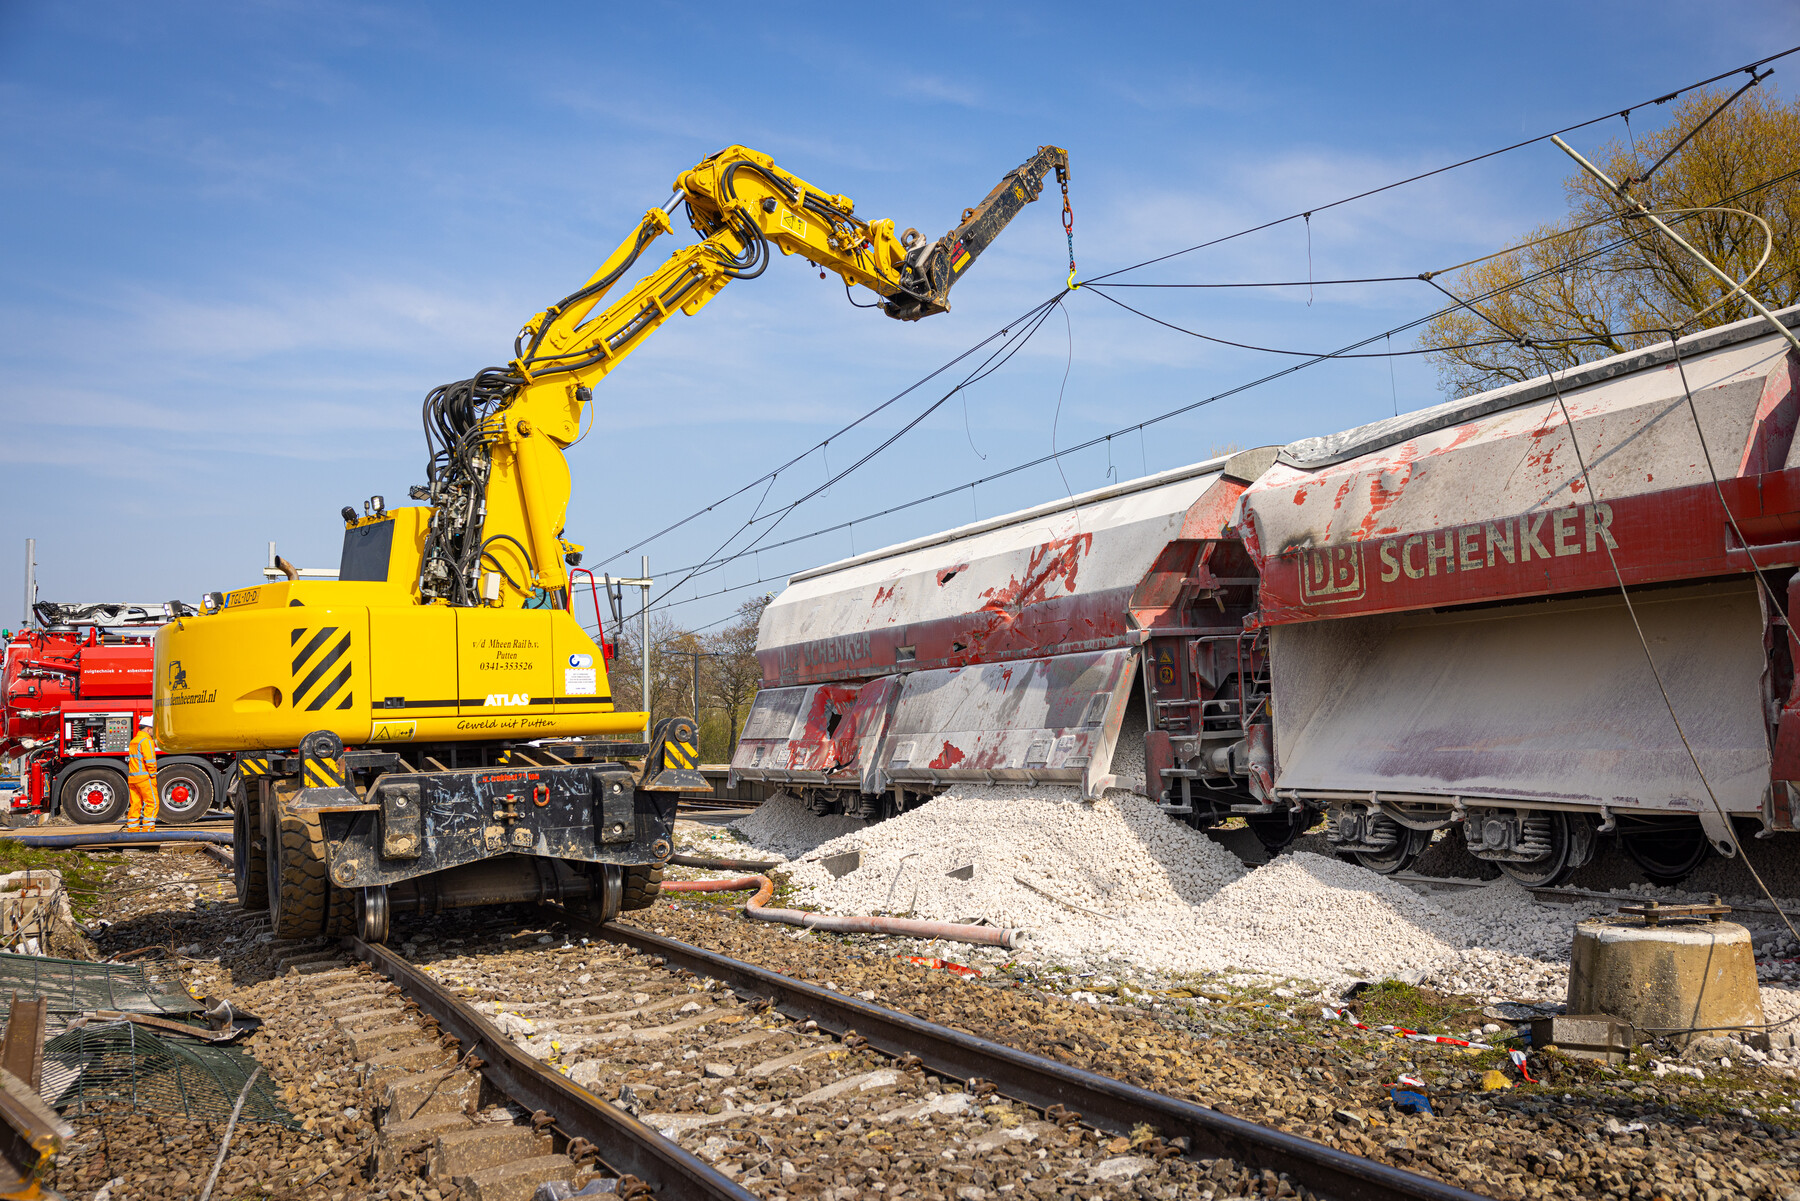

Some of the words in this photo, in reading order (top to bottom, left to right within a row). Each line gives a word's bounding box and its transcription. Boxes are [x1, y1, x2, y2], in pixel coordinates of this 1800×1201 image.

[1303, 543, 1361, 598] DB
[1380, 504, 1619, 583] SCHENKER
[231, 590, 257, 605] TGL-10-D
[472, 639, 486, 649] v/d
[488, 639, 512, 649] Mheen
[512, 639, 527, 649] Rail
[527, 639, 540, 649] b.v.
[803, 632, 872, 667] SCHENKER
[496, 650, 518, 660] Putten
[479, 661, 533, 671] 0341-353526
[484, 693, 529, 707] ATLAS
[457, 718, 498, 731] Geweld
[500, 718, 518, 729] uit
[520, 717, 557, 729] Putten
